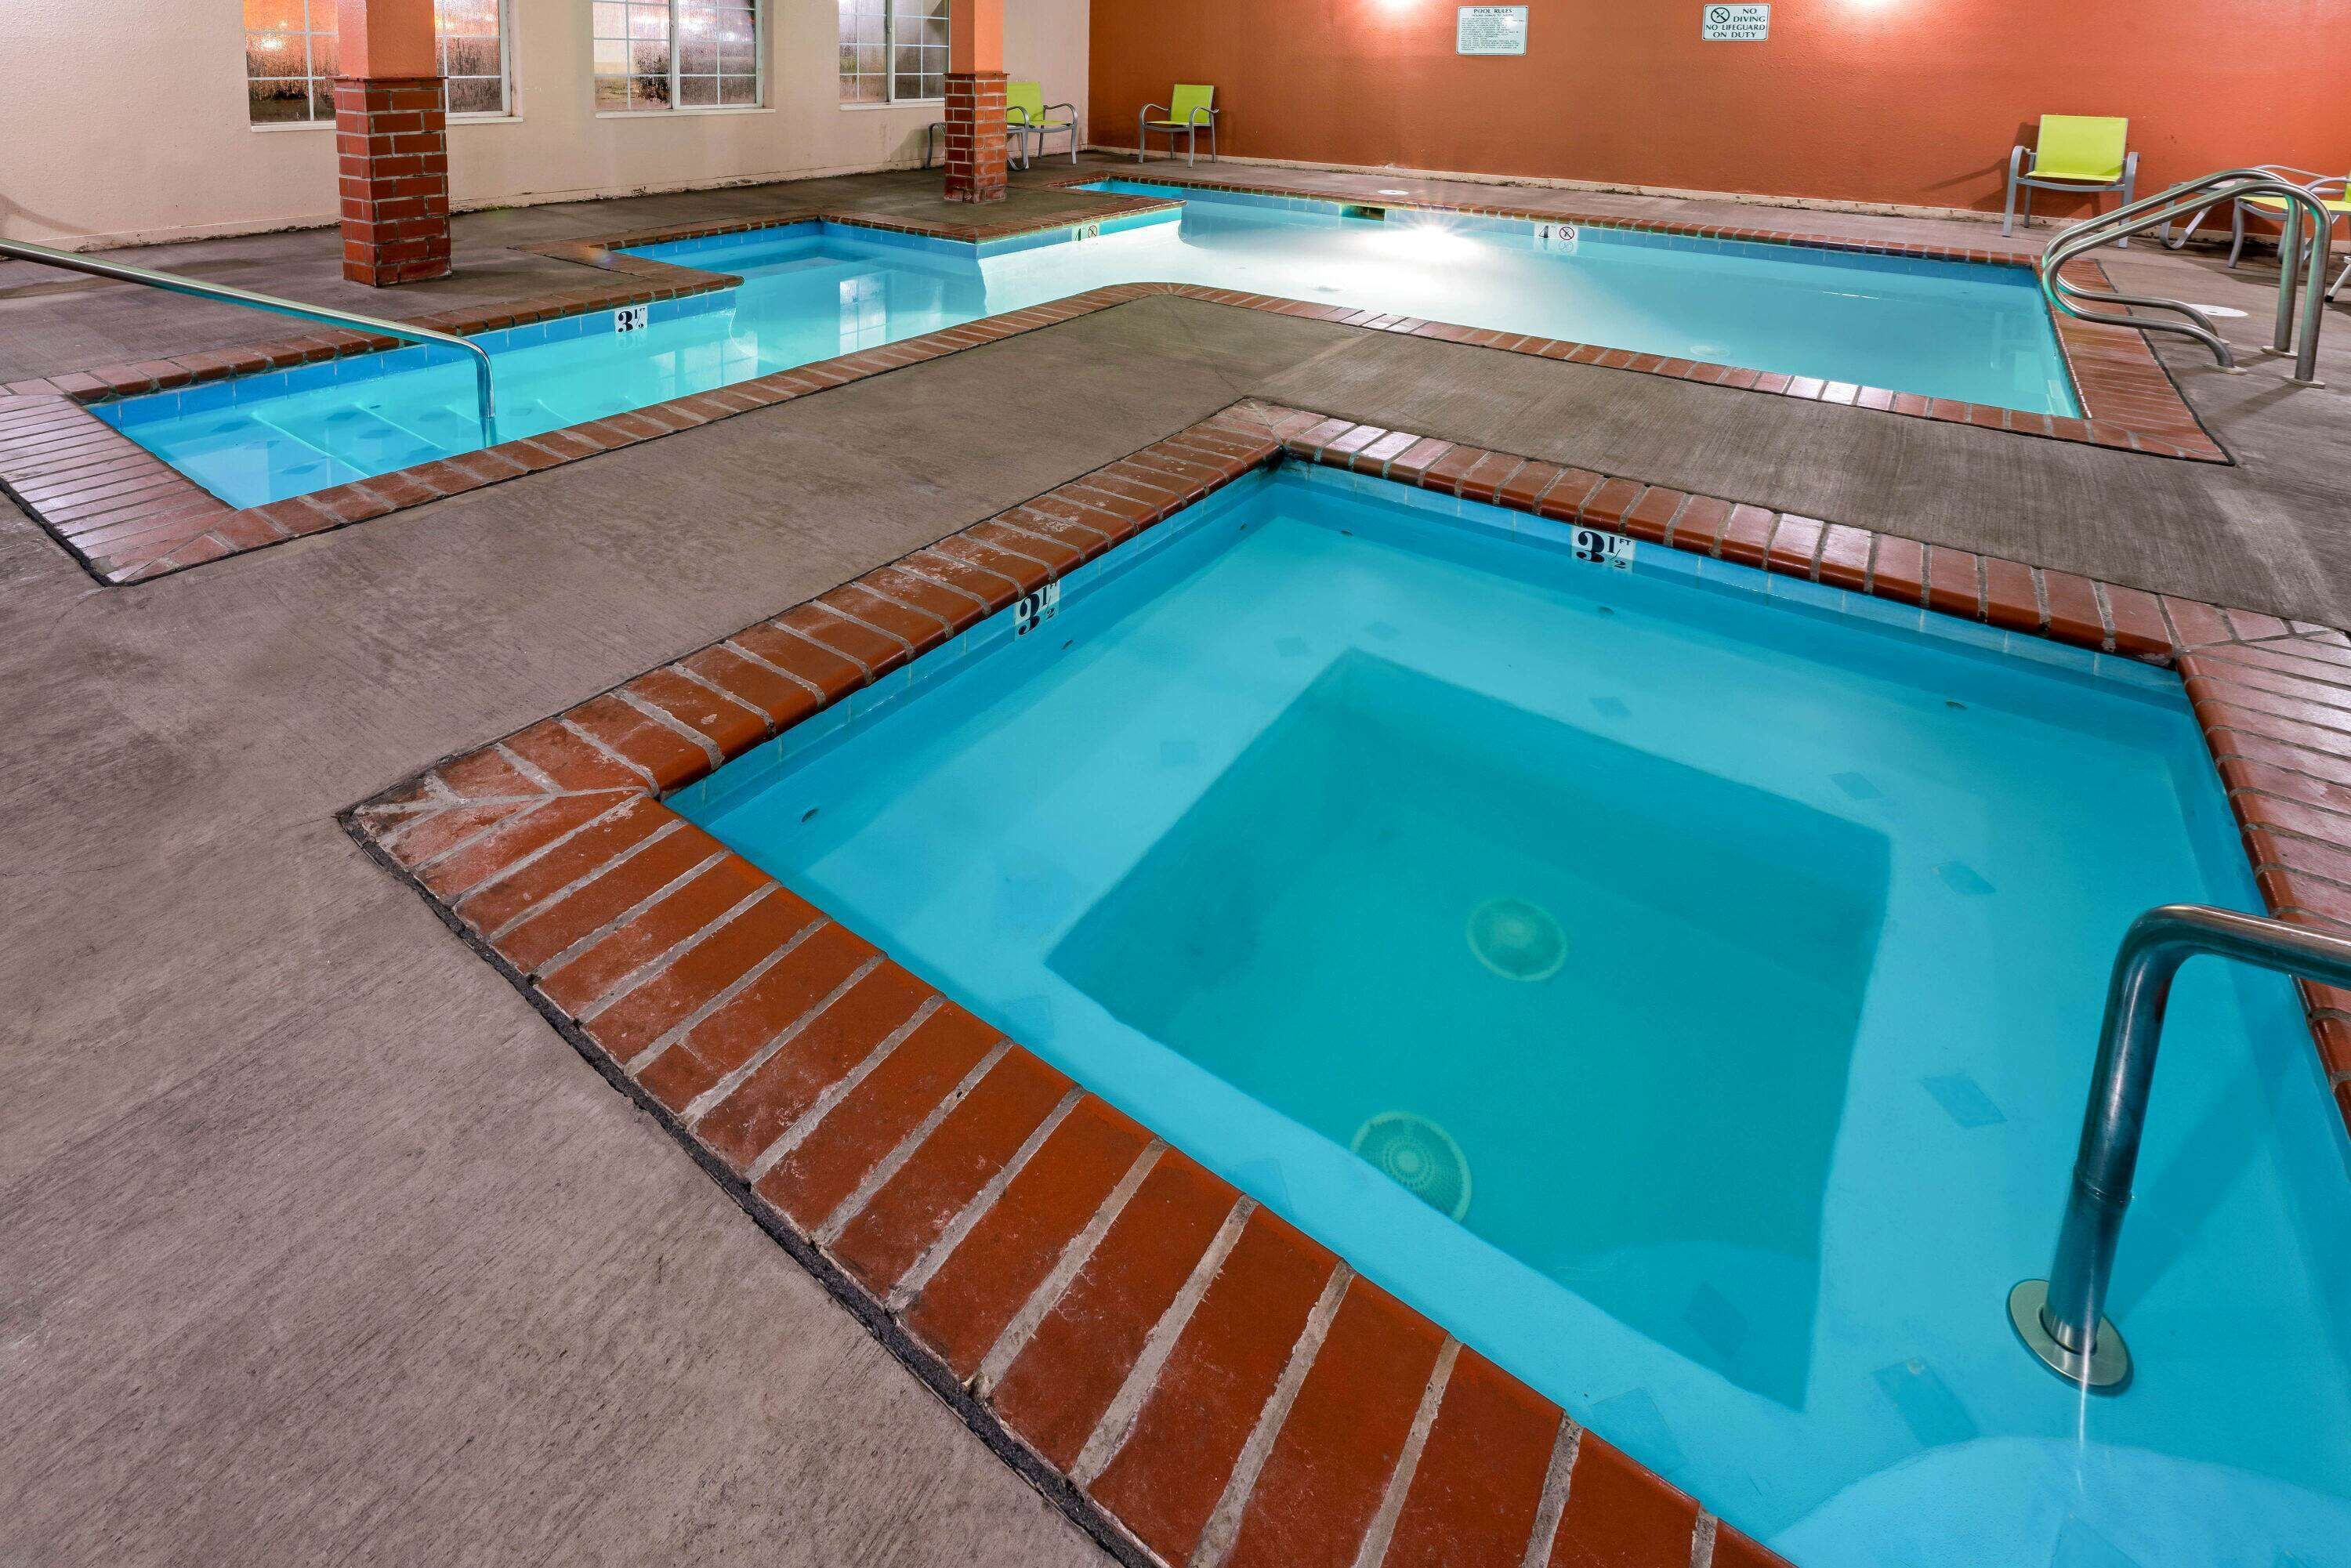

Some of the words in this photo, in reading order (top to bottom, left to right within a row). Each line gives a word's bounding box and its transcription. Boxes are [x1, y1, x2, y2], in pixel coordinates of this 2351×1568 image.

[1538, 225, 1550, 239] 4
[618, 310, 633, 333] 3
[1576, 531, 1605, 563] 3
[1018, 592, 1041, 636] 3
